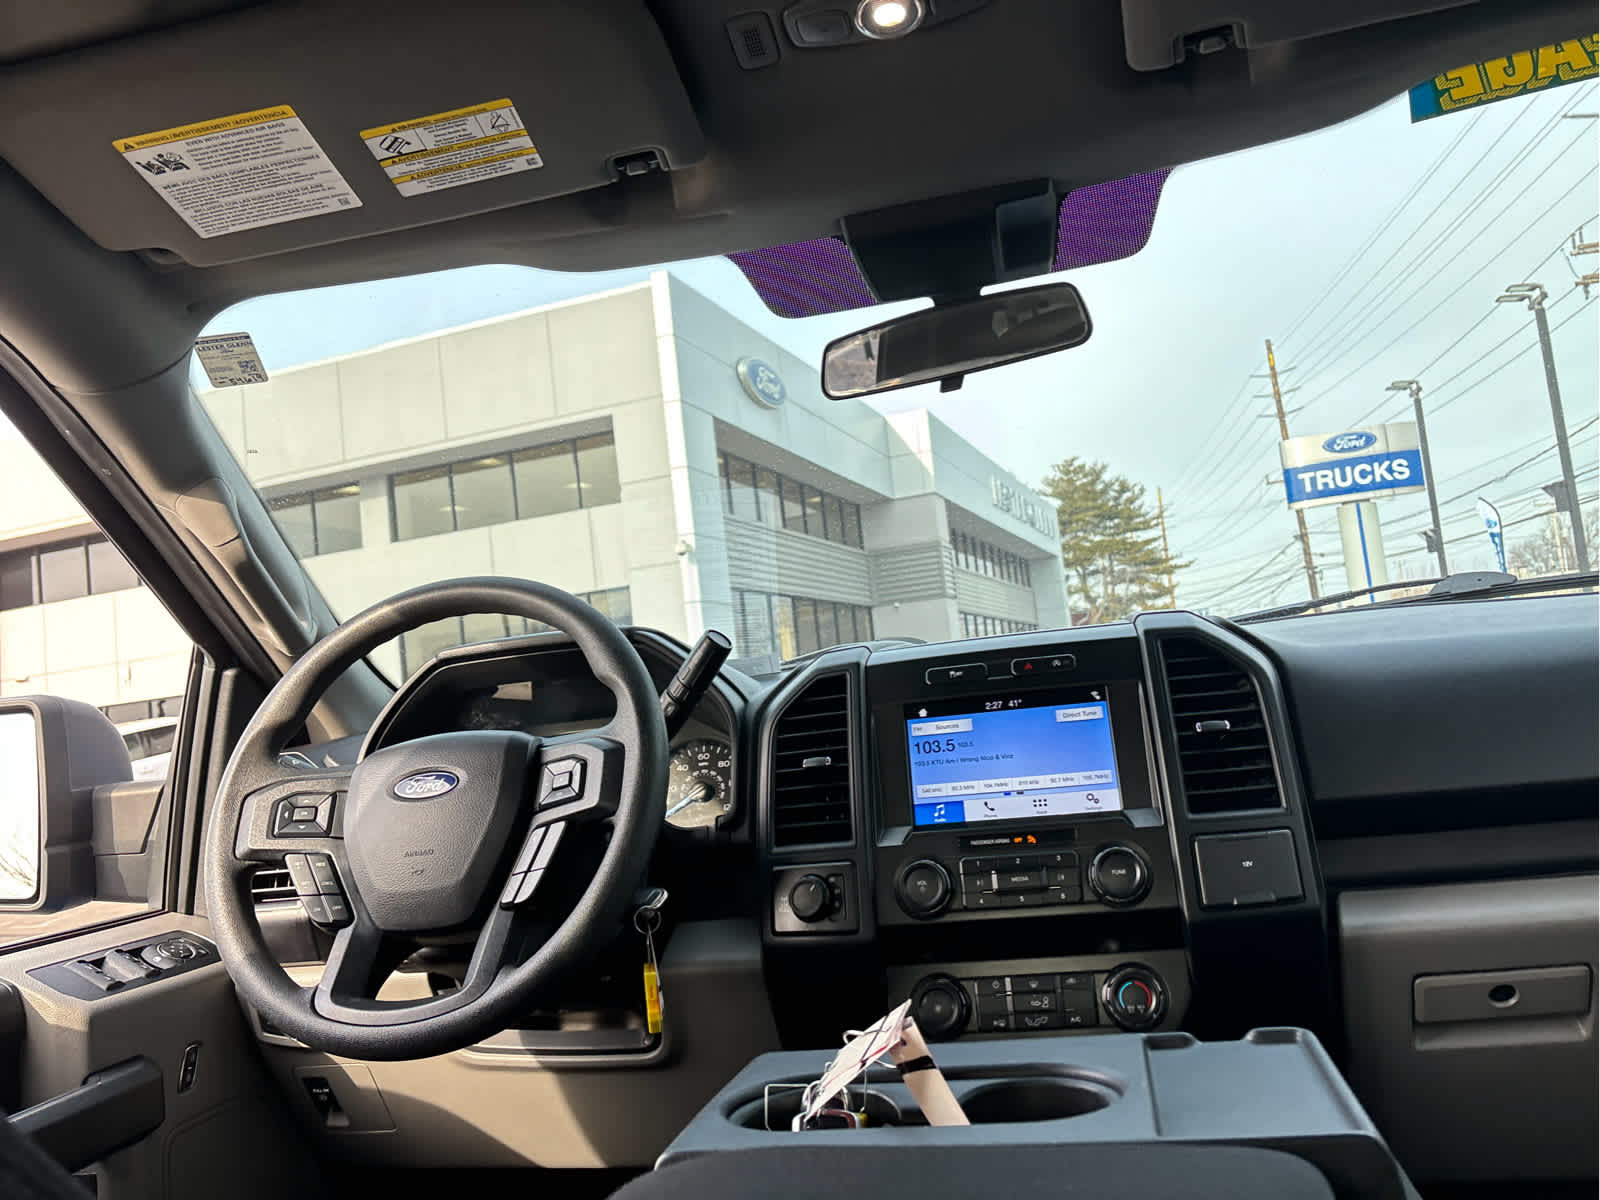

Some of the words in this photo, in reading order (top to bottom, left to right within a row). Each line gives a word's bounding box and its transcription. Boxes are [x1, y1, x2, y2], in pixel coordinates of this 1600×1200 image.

[1297, 458, 1411, 493] TRUCKS
[984, 701, 1003, 710] 2:27
[914, 738, 956, 755] 103.5
[697, 752, 711, 761] 60
[676, 764, 689, 772] 40
[717, 760, 730, 768] 80
